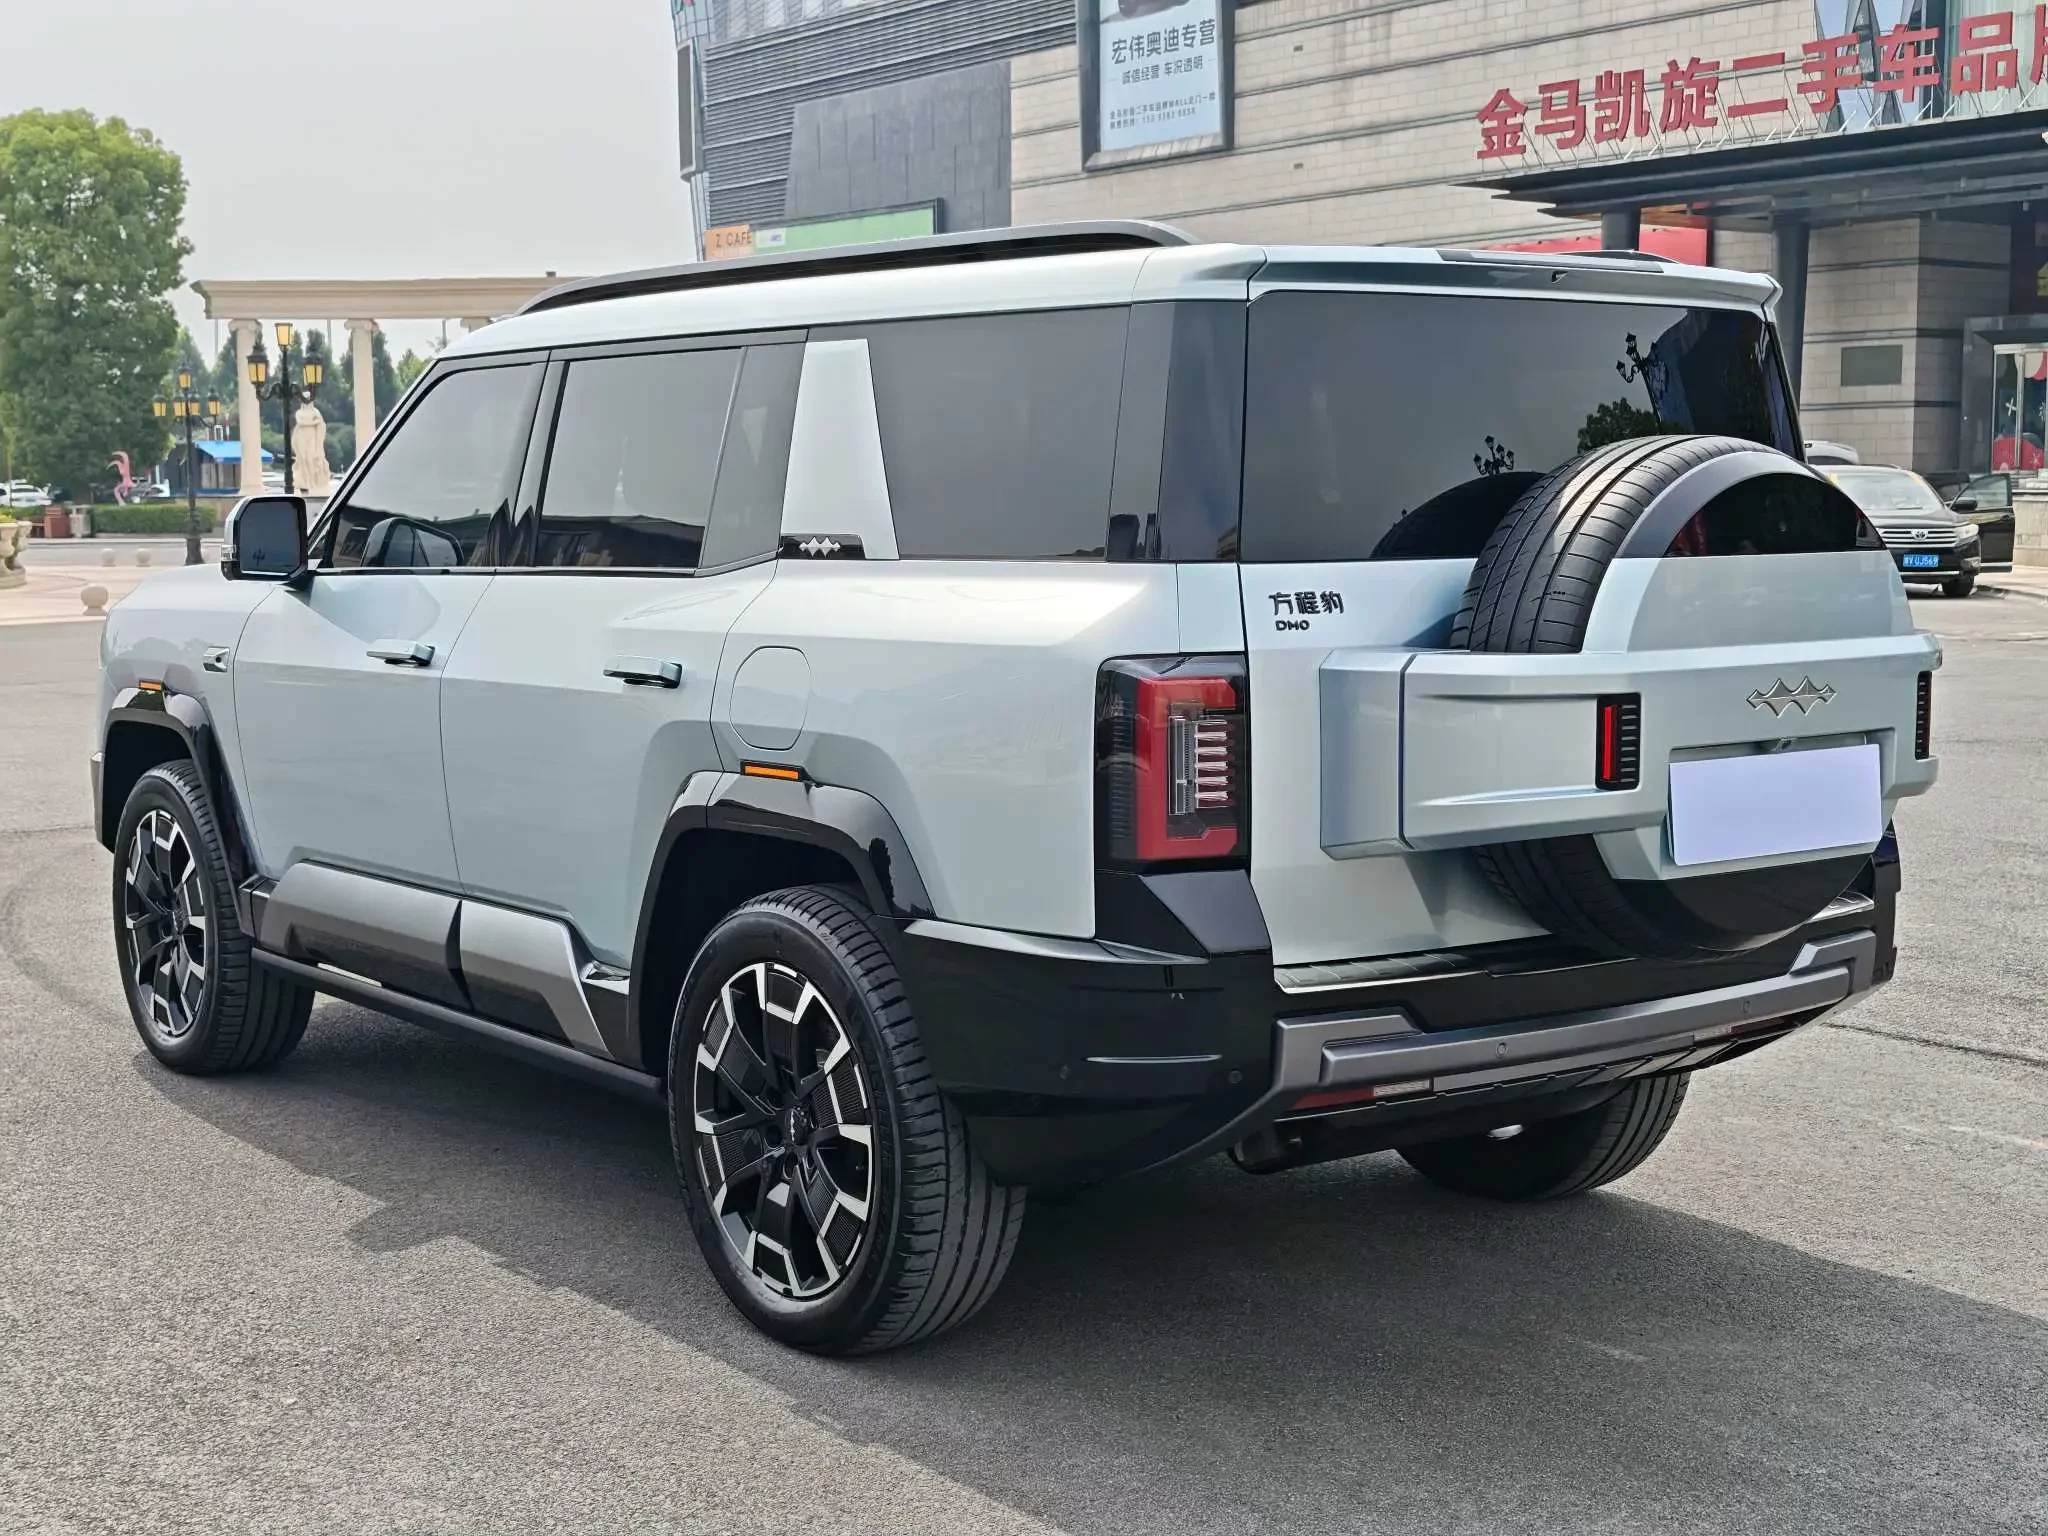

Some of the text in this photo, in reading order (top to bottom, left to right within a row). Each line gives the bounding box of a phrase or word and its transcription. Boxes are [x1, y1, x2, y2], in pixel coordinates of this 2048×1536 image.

[1111, 18, 1216, 65] 宏伟奥迪专营
[1164, 55, 1203, 77] 车况透明
[1477, 4, 2048, 160] 金马凯旋二手车品
[1268, 591, 1344, 615] 方程豹
[1275, 620, 1310, 631] DMO
